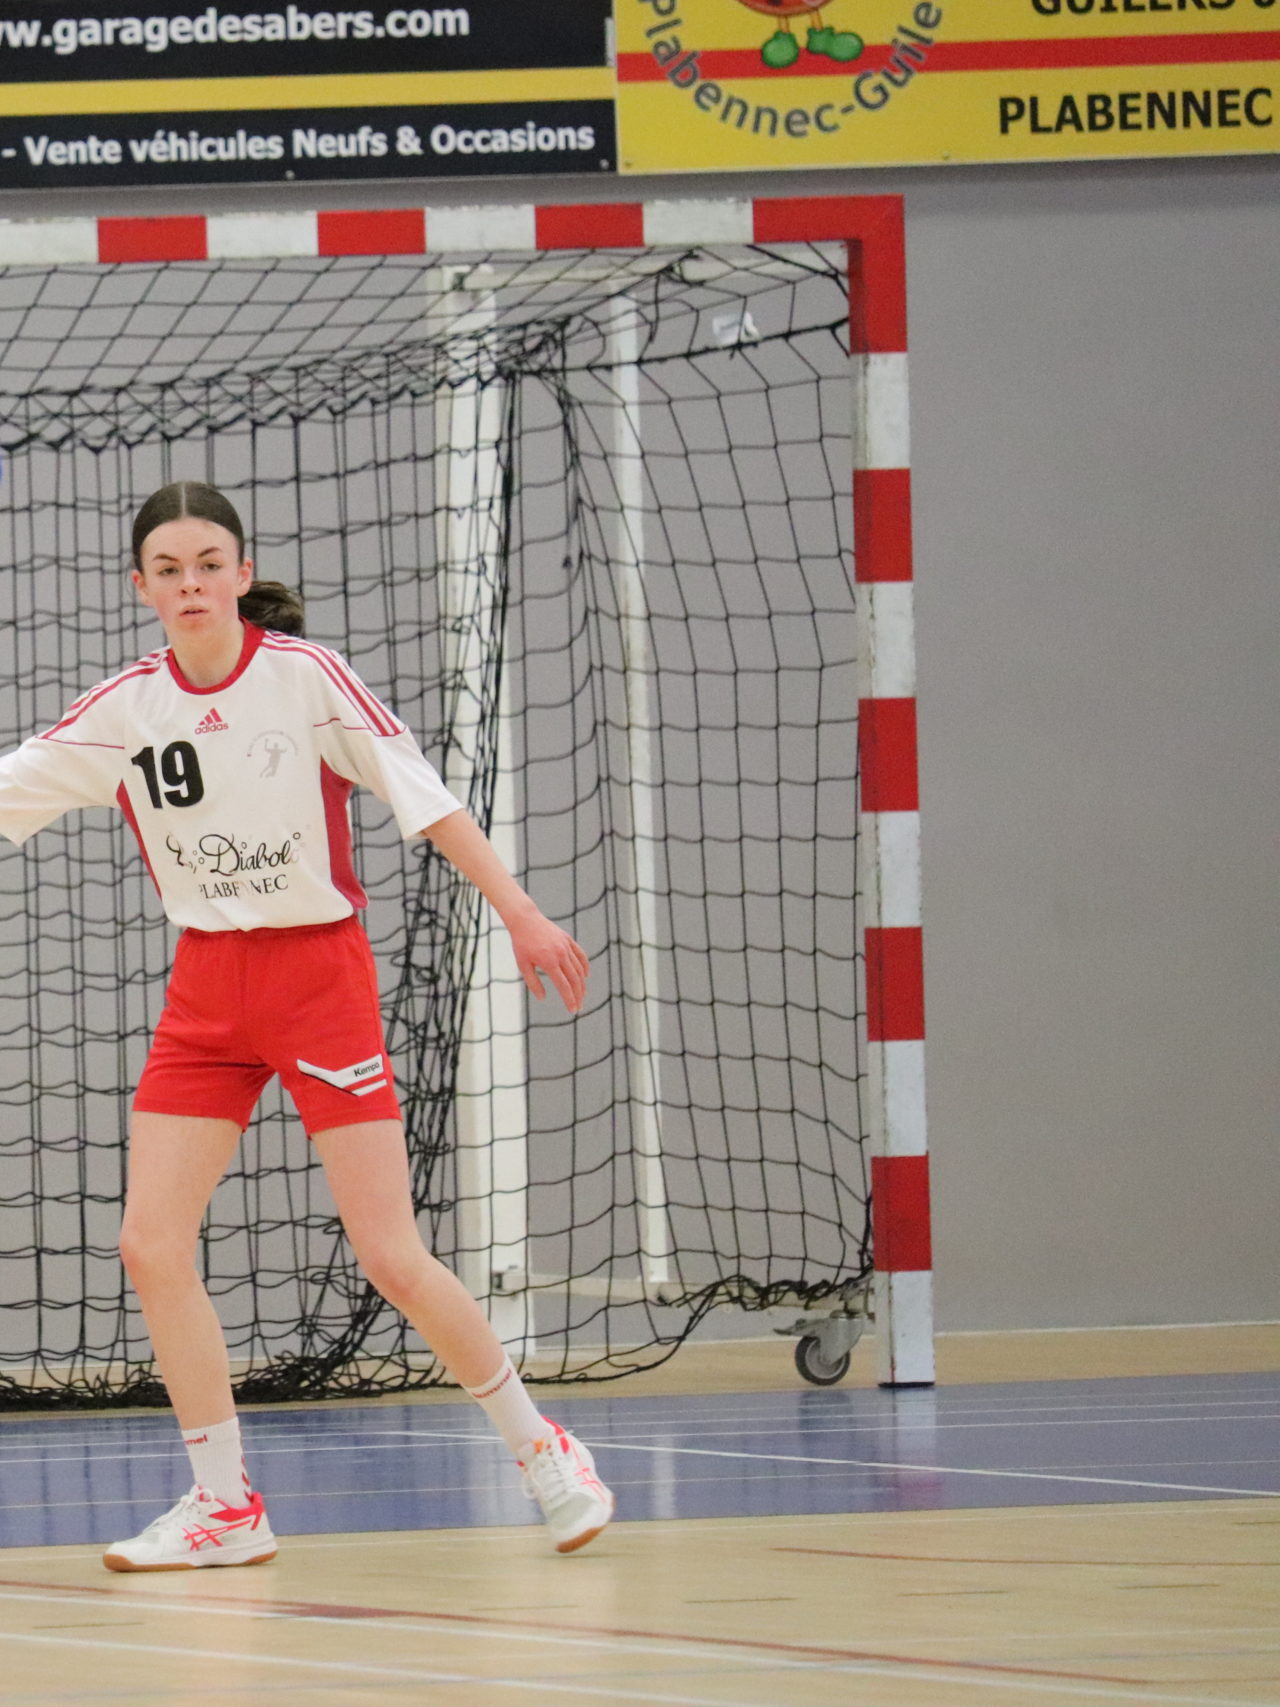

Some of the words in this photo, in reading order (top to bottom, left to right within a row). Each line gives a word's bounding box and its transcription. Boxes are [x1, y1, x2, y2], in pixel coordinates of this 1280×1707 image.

[999, 87, 1273, 134] PLABENNEC
[24, 135, 122, 166] Vente
[130, 129, 284, 163] véhicules
[292, 126, 388, 158] Neufs
[395, 126, 423, 155] &
[431, 121, 596, 154] Occasions
[194, 722, 229, 735] adidas
[131, 741, 205, 810] 19
[353, 1062, 380, 1077] Kempa
